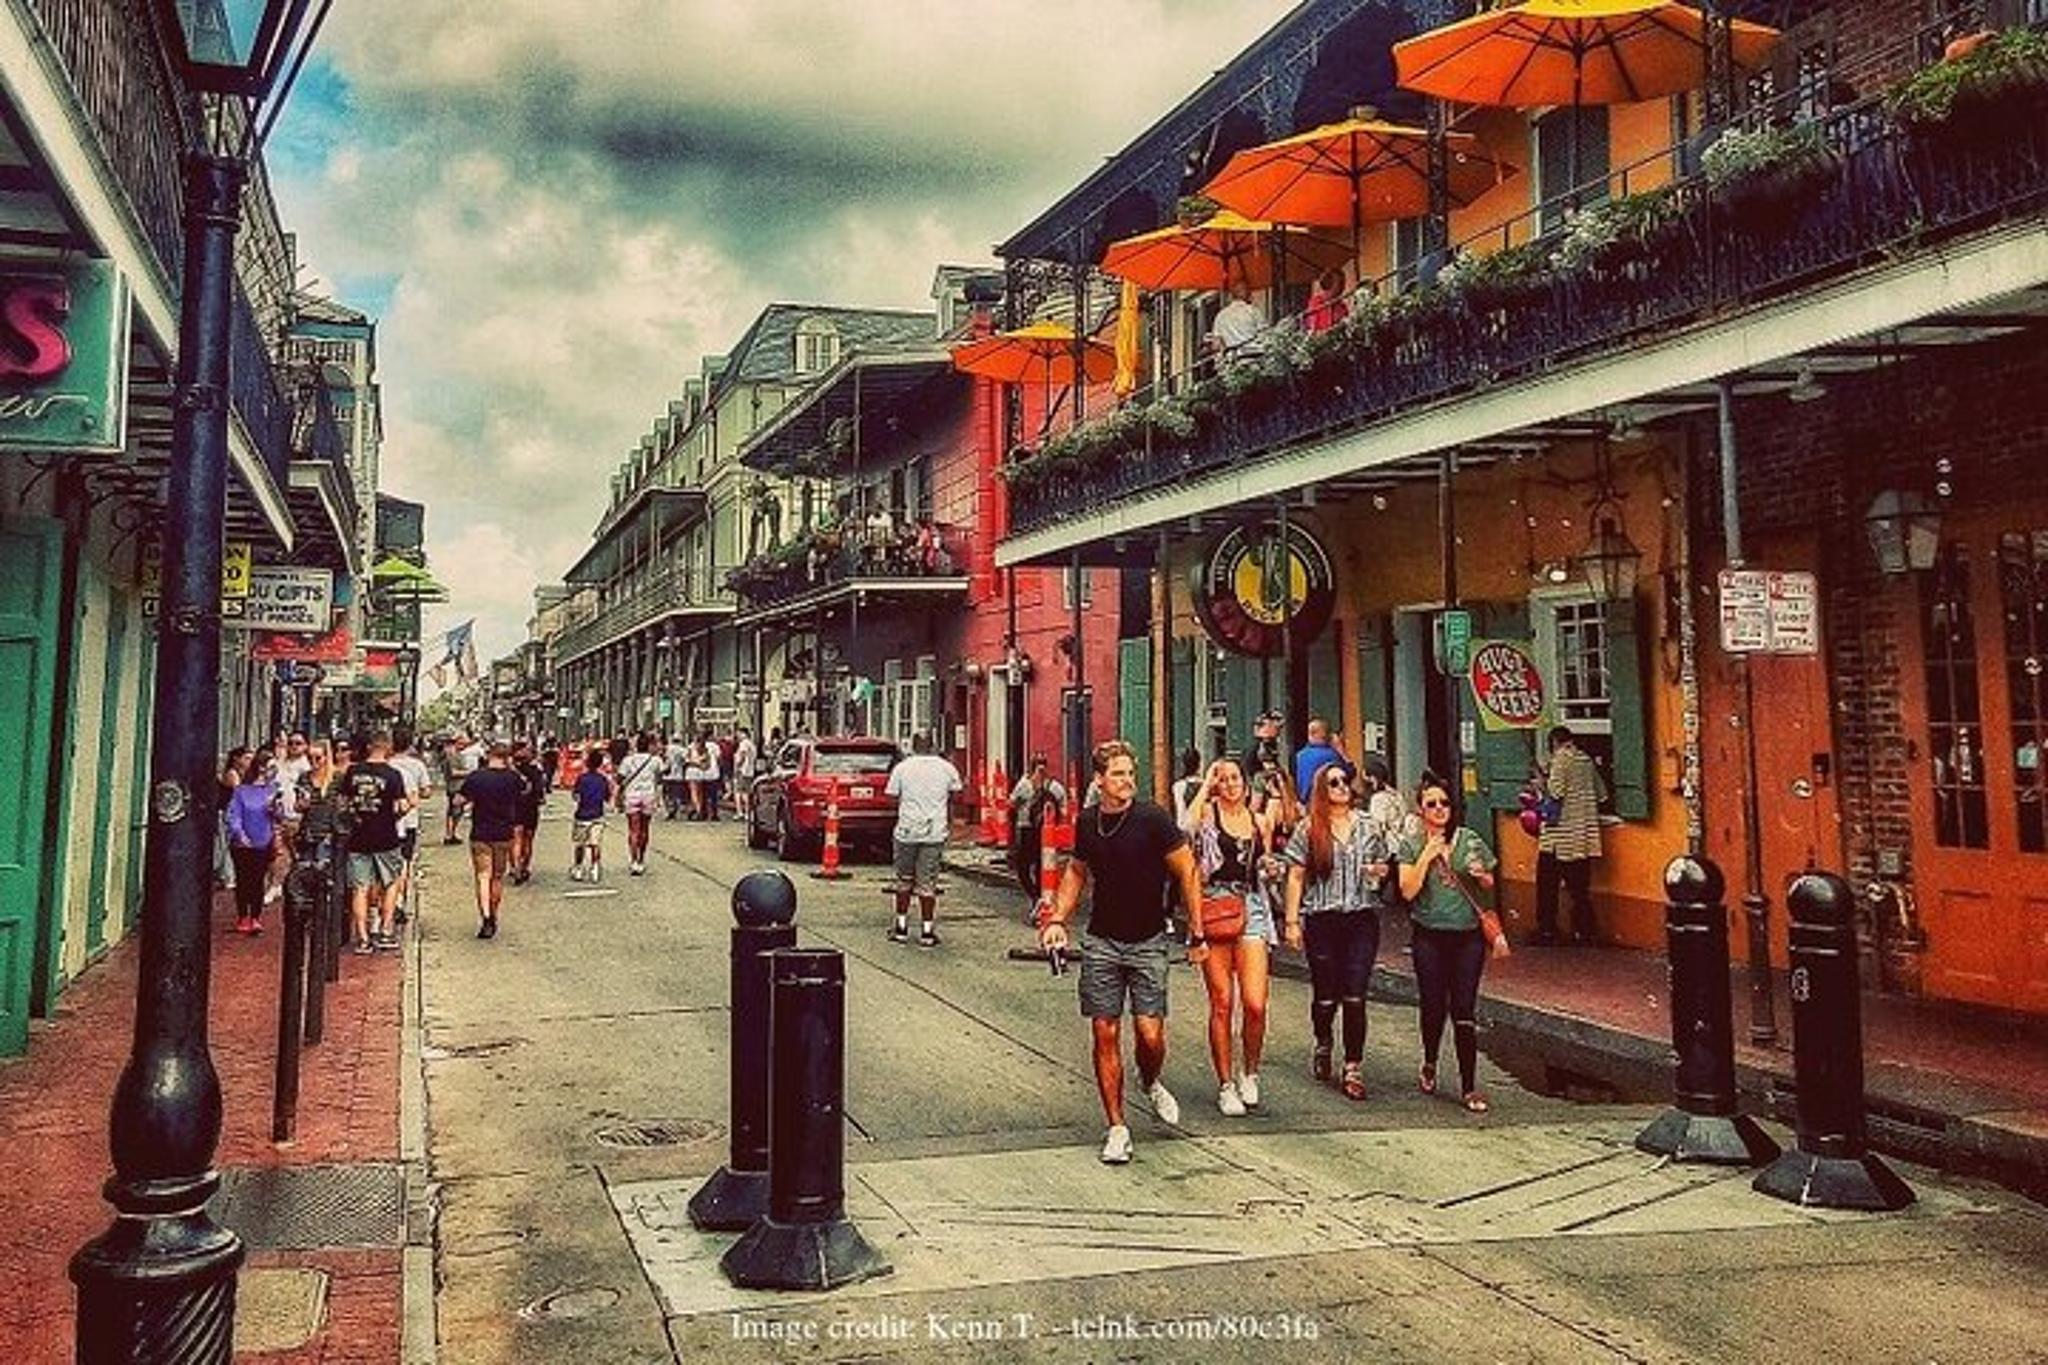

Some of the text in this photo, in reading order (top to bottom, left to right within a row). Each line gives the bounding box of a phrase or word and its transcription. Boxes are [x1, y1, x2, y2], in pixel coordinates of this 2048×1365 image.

[1479, 647, 1528, 673] HUGE
[1489, 671, 1528, 690] ASS
[1486, 690, 1540, 717] BEERS
